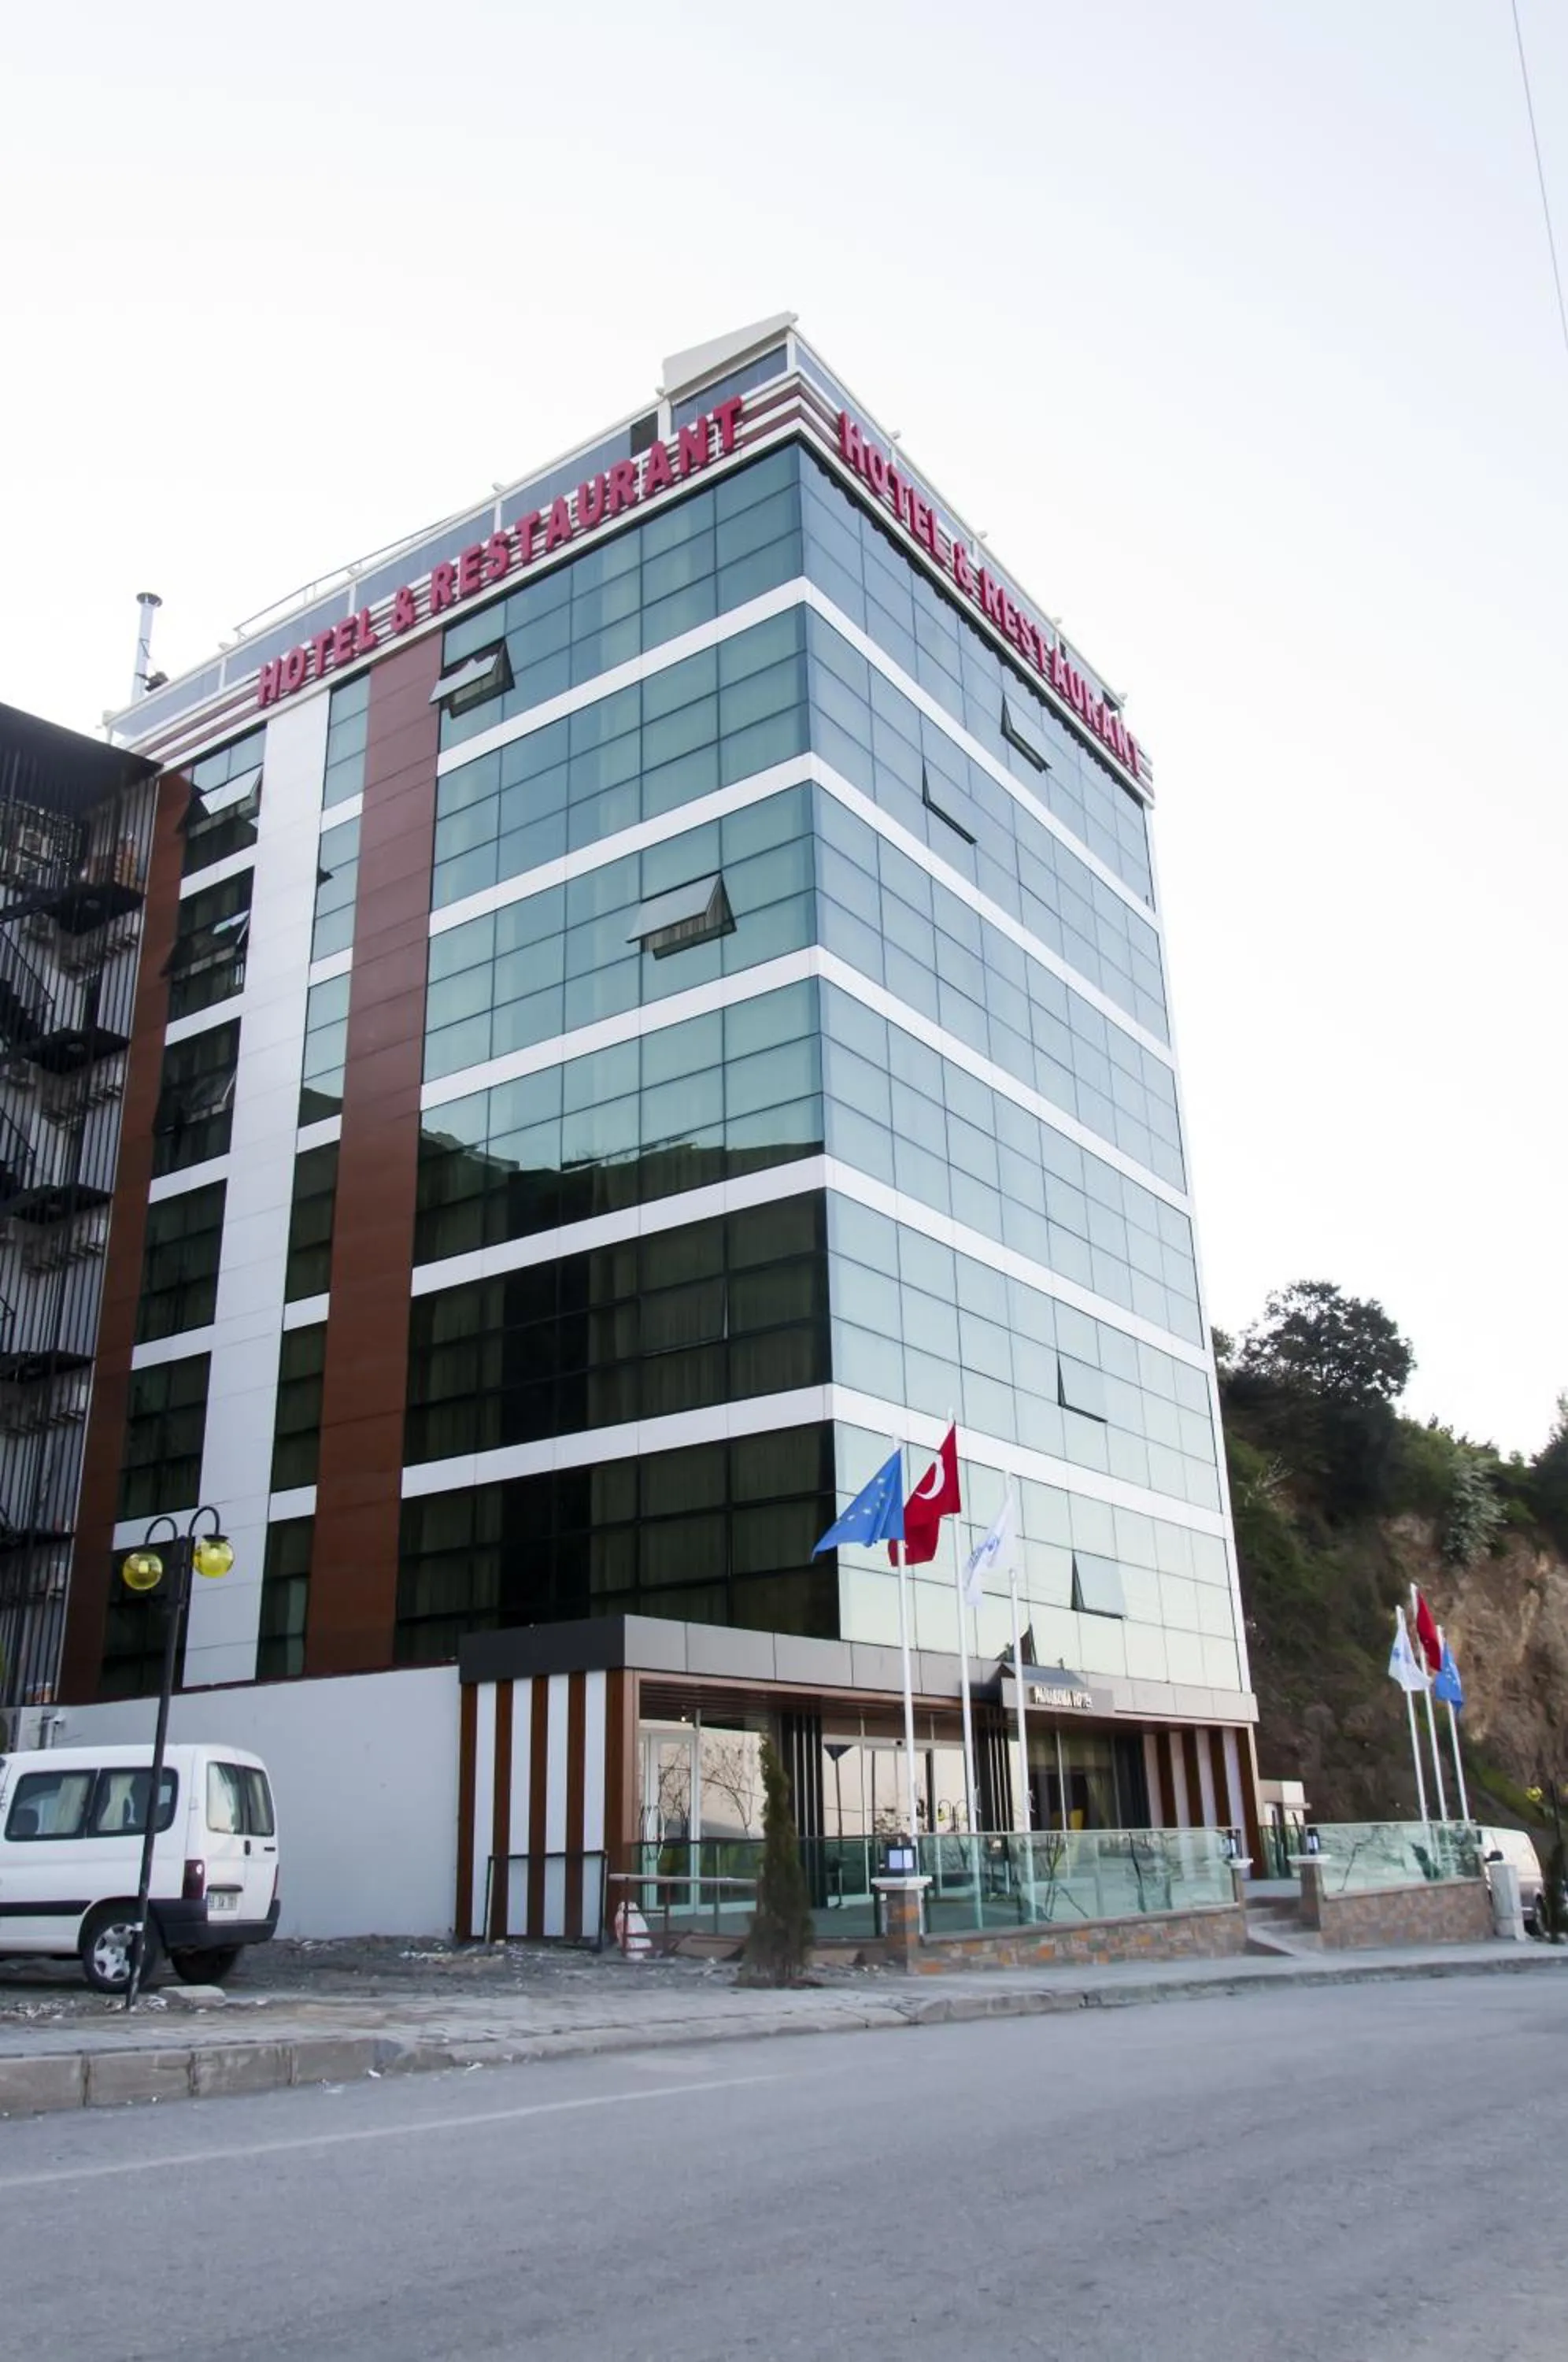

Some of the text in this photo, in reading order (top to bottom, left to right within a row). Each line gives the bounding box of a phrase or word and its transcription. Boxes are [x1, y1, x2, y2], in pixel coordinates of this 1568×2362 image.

[257, 395, 742, 705] HOTEL & RESTAURANT
[838, 410, 1140, 776] HOTEL & RESTAURANT
